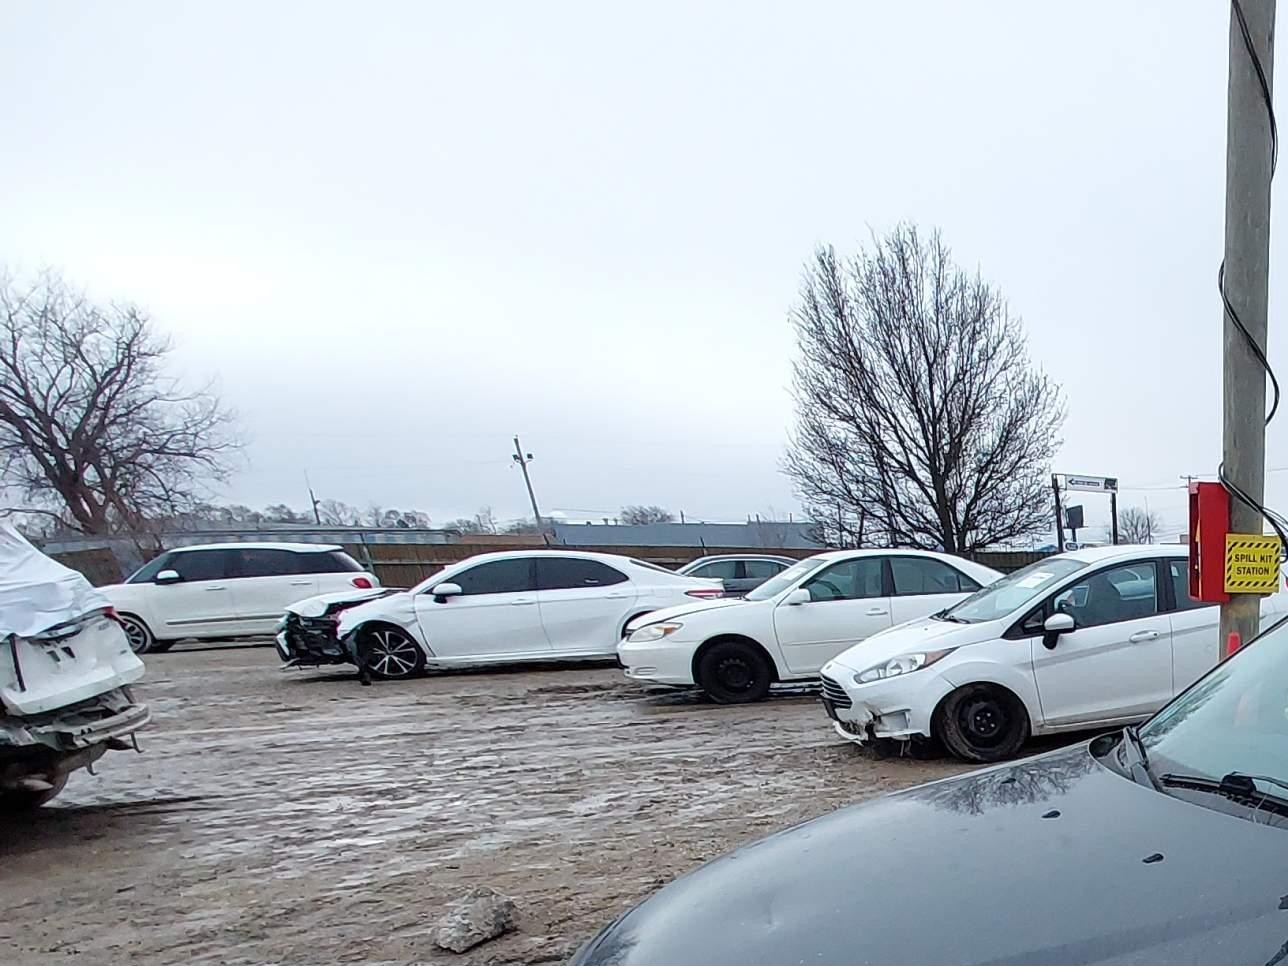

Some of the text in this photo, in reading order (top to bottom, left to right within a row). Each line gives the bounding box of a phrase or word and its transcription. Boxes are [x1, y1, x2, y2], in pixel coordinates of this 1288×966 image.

[1234, 553, 1273, 564] SPILL KIT
[1236, 566, 1270, 576] STATION
